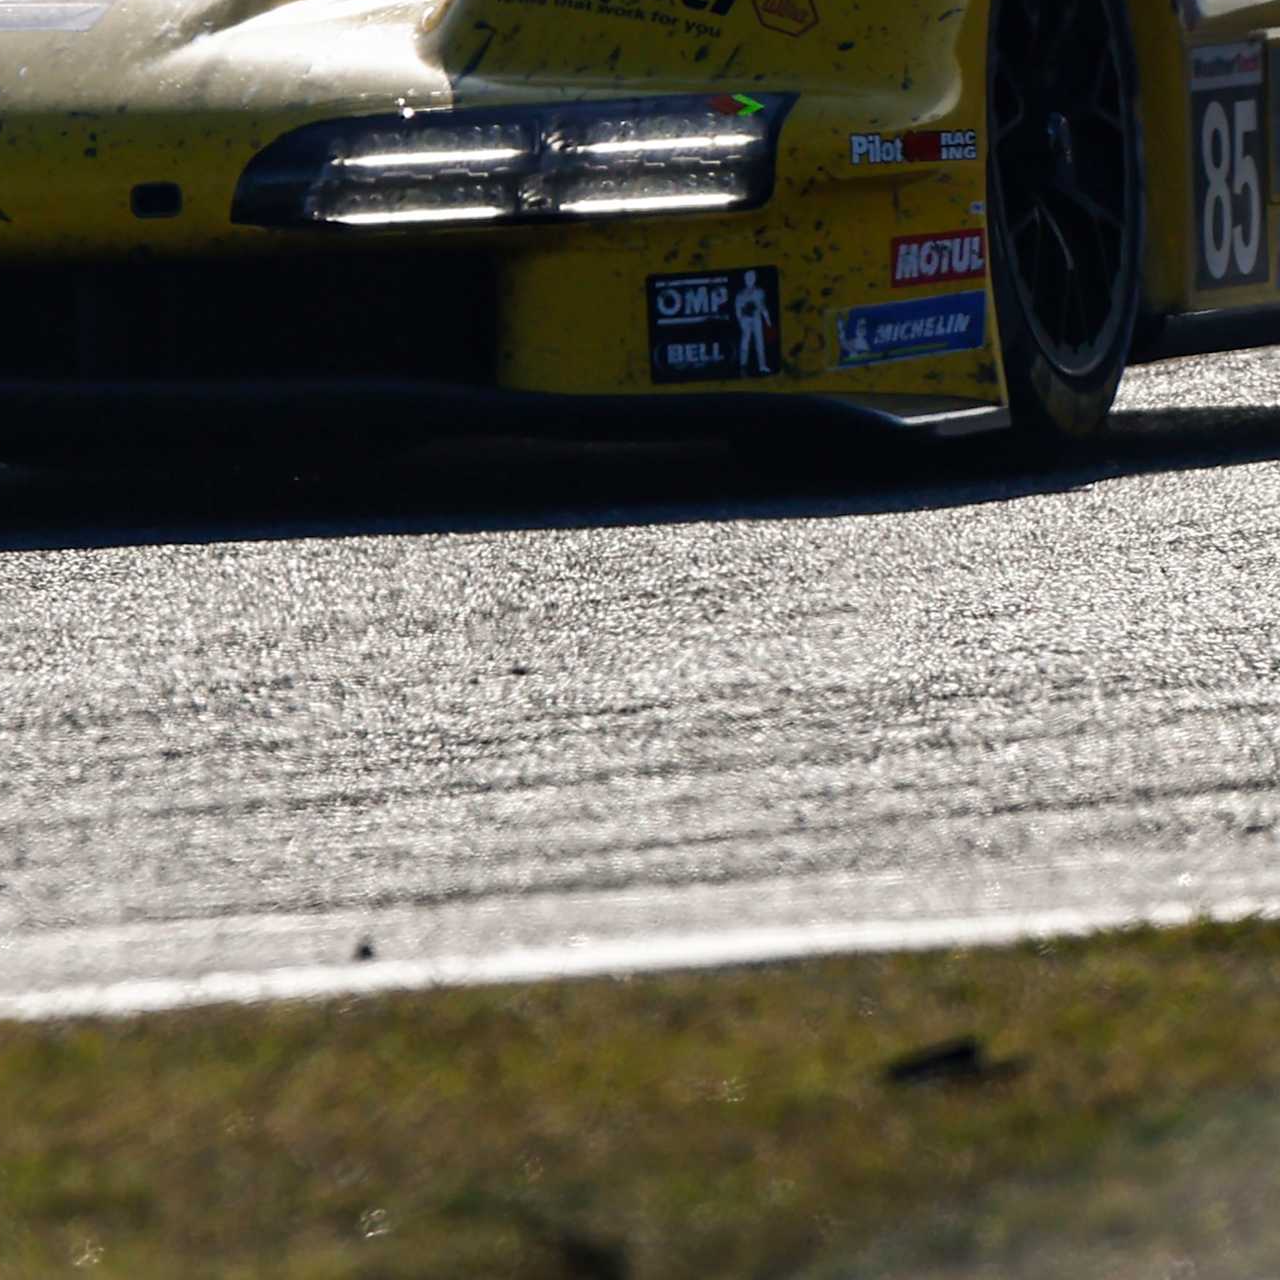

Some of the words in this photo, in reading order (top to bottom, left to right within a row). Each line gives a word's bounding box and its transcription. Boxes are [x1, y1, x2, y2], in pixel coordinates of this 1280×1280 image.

[596, 1, 645, 20] work
[651, 9, 679, 26] for
[685, 21, 720, 39] you
[851, 134, 903, 164] Pilot
[940, 132, 976, 146] RAC
[940, 146, 976, 160] ING
[1202, 100, 1261, 280] 85
[895, 236, 984, 280] MOTUL
[656, 286, 729, 316] OMP
[874, 313, 970, 344] MICHELIN
[666, 342, 726, 365] BELL
